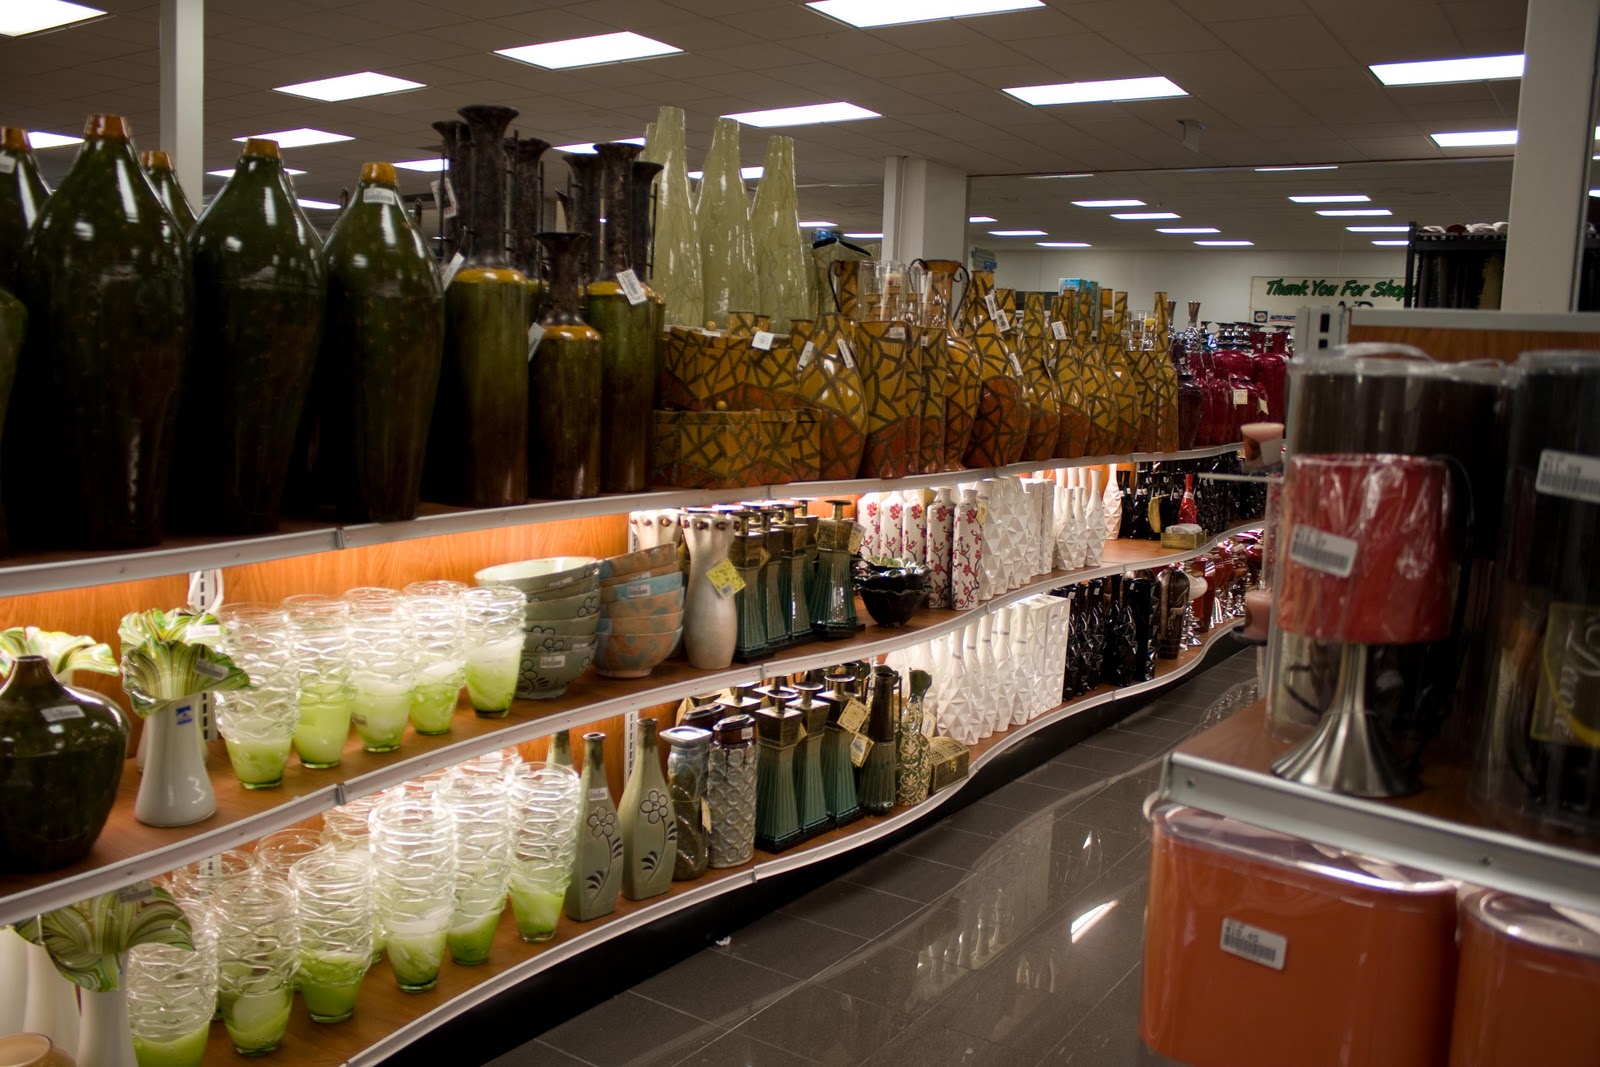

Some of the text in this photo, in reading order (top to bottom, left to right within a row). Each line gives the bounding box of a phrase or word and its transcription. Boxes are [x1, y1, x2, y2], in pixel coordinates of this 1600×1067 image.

[1266, 279, 1416, 302] Thank You For Shop
